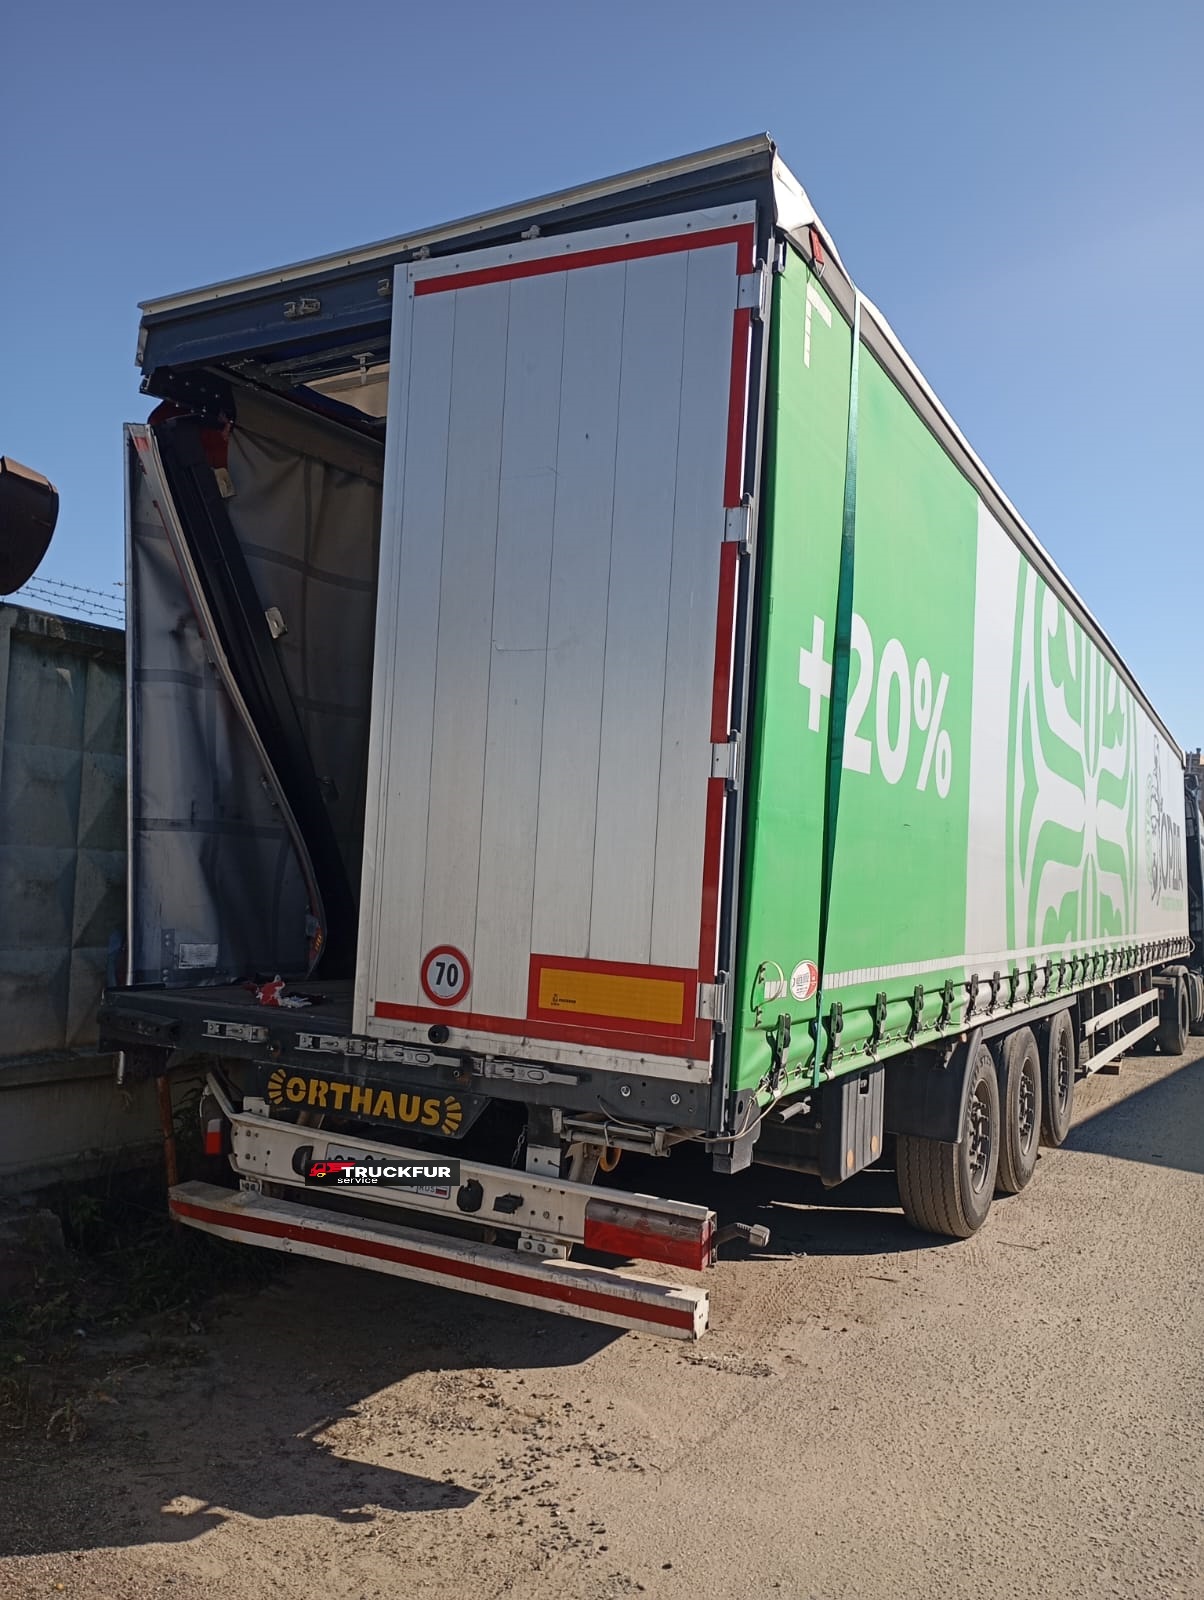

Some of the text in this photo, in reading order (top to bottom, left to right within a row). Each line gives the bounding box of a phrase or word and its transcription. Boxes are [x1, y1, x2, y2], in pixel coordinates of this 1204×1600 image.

[799, 611, 952, 799] +20%
[435, 961, 459, 988] 70
[286, 1076, 442, 1127] ORTHAUS
